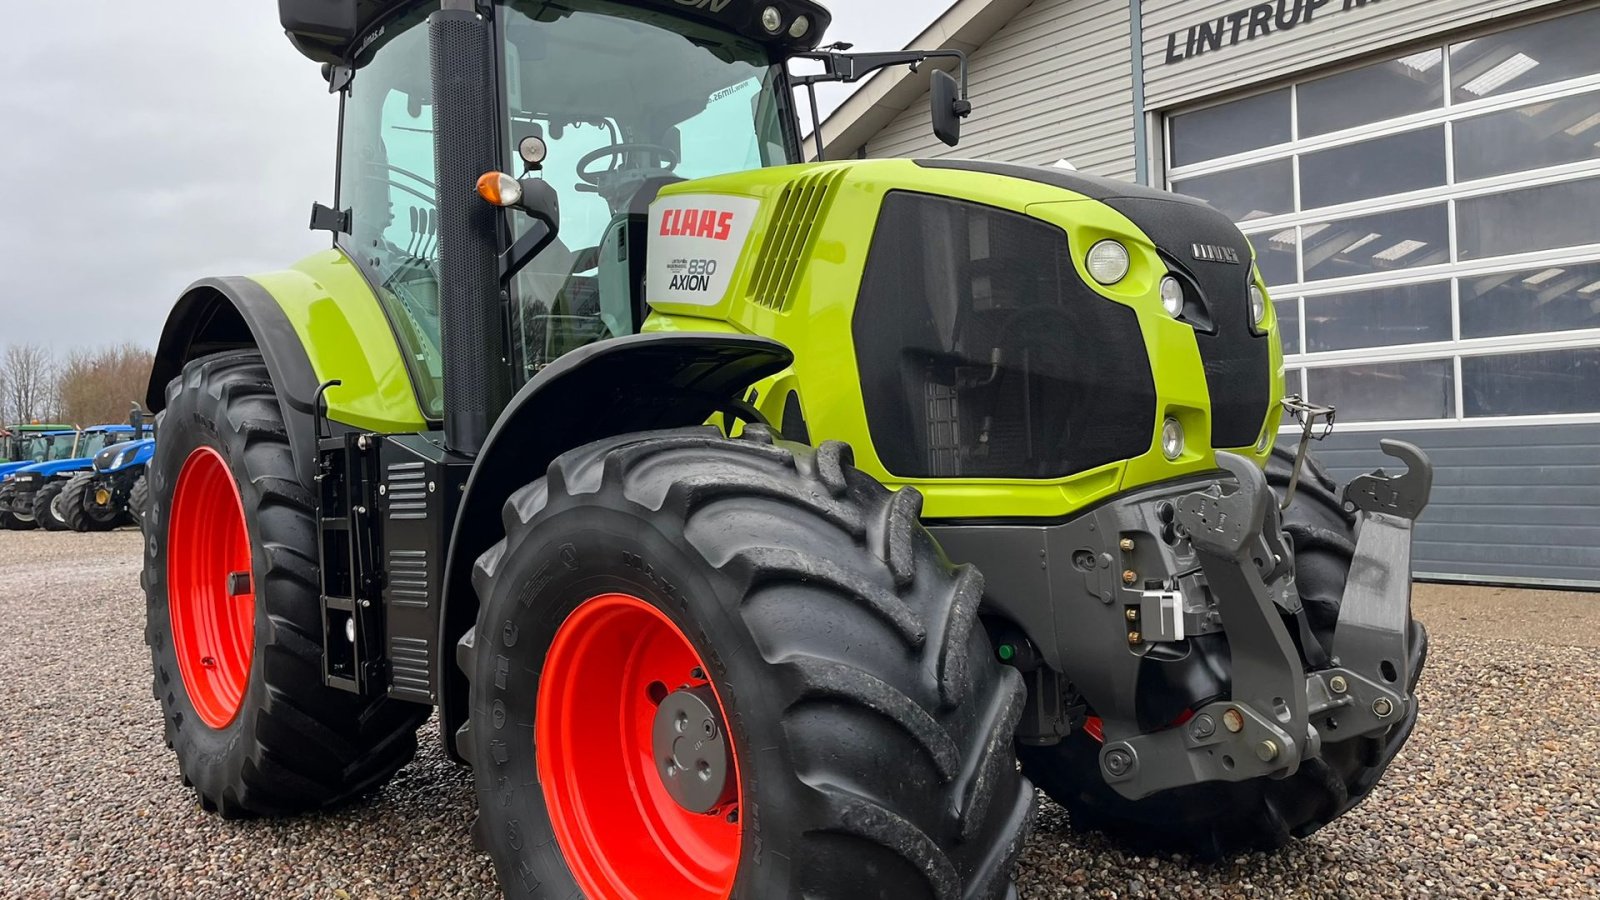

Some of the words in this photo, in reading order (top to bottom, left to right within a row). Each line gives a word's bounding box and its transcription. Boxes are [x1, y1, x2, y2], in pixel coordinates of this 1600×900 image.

[1165, 0, 1329, 64] LINTRUP
[660, 209, 733, 240] CLAAS
[688, 259, 717, 275] 830
[668, 274, 710, 291] AXION
